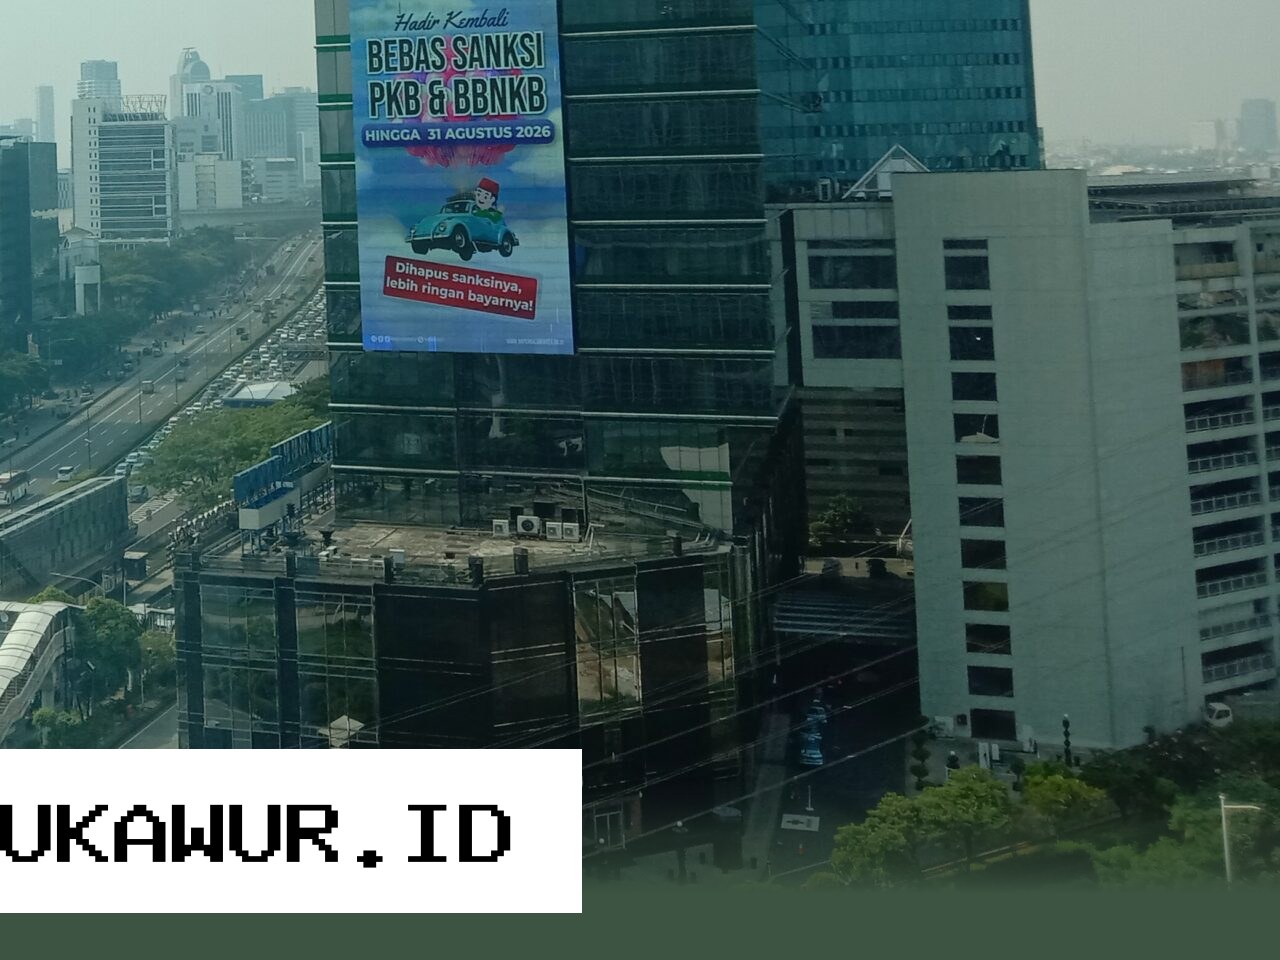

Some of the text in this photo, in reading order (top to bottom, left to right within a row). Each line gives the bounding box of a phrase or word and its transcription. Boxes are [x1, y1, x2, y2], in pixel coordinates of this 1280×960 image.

[394, 7, 510, 32] Hadir Kembali
[367, 30, 545, 74] BEBAS SANKSI
[367, 74, 548, 118] PKB & BBNKB
[365, 124, 552, 142] HINGGA 31 AGUSTUS 2026
[386, 277, 534, 312] lebih ringan bayarnya!
[395, 261, 522, 294] Dihapus sanksinya,
